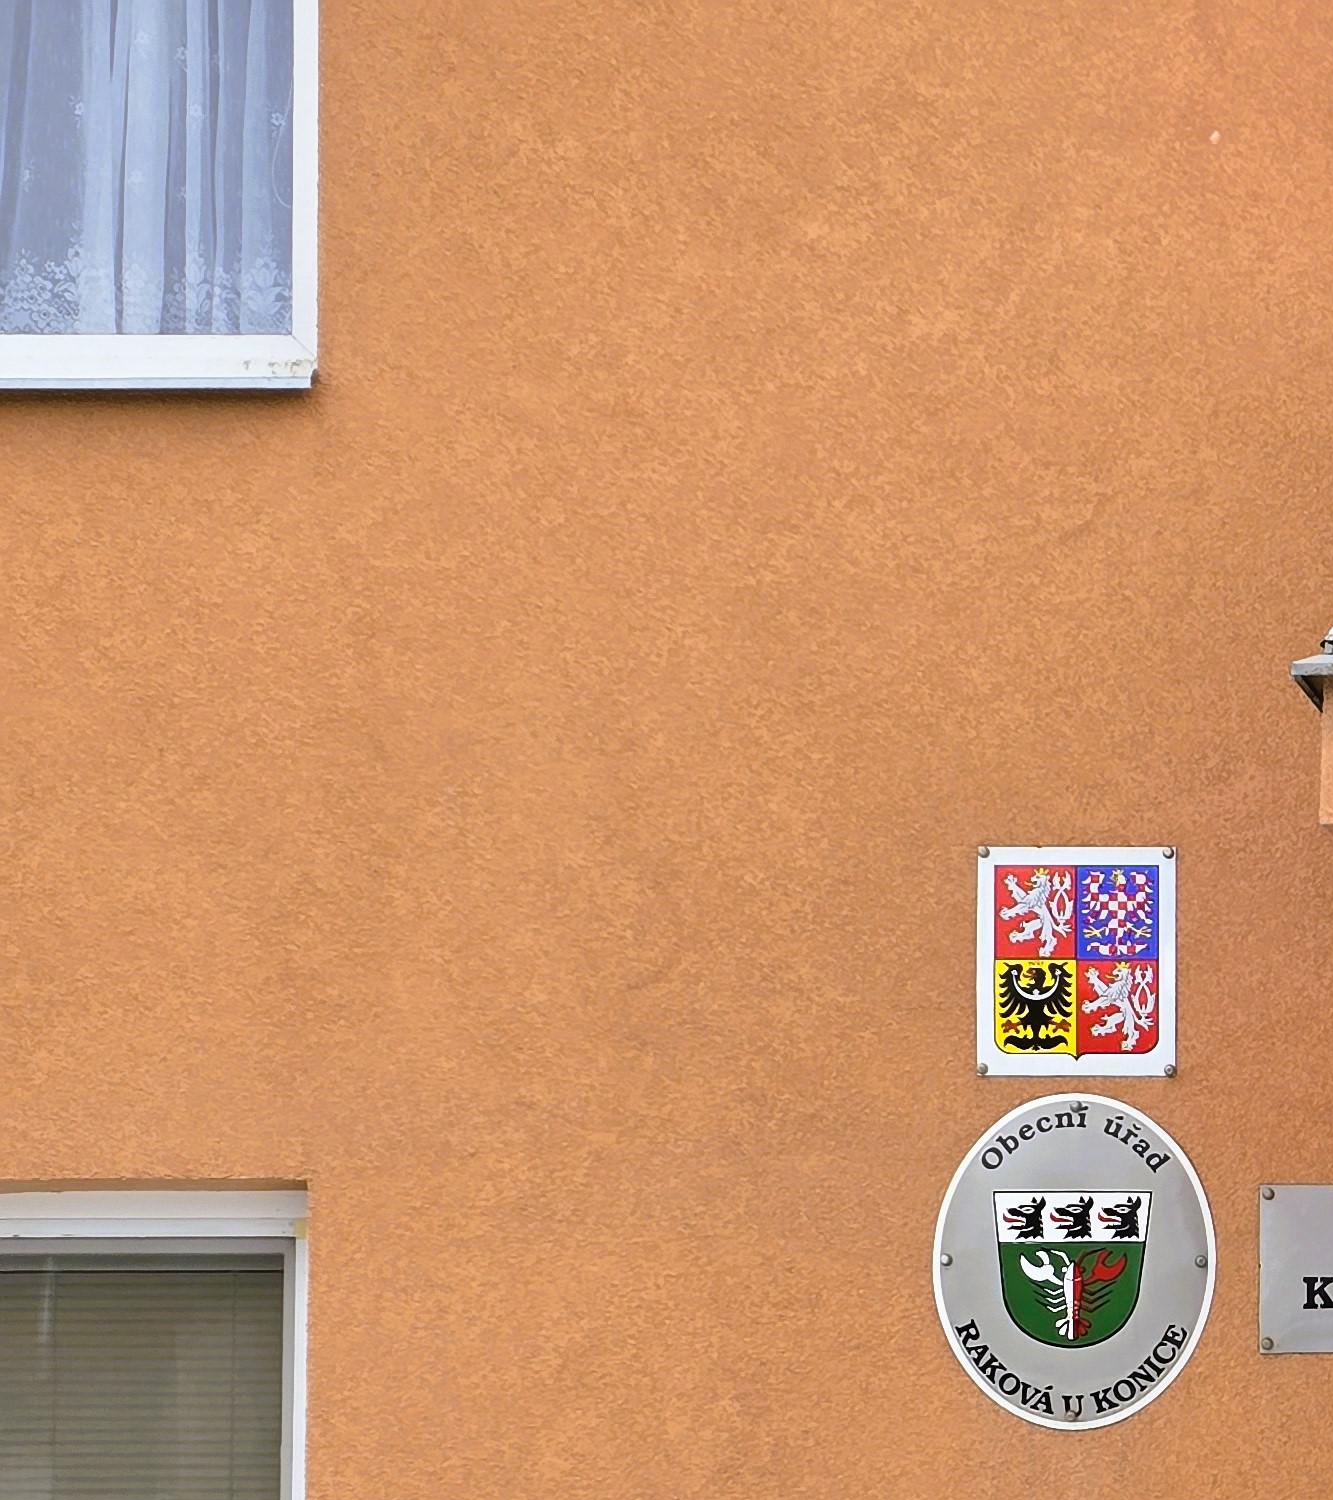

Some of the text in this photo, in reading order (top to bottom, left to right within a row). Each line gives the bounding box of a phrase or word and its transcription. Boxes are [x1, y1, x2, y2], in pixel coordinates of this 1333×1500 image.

[981, 1105, 1172, 1175] Obecní úřad
[955, 1318, 1188, 1418] RAKOVÁ U KONICE
